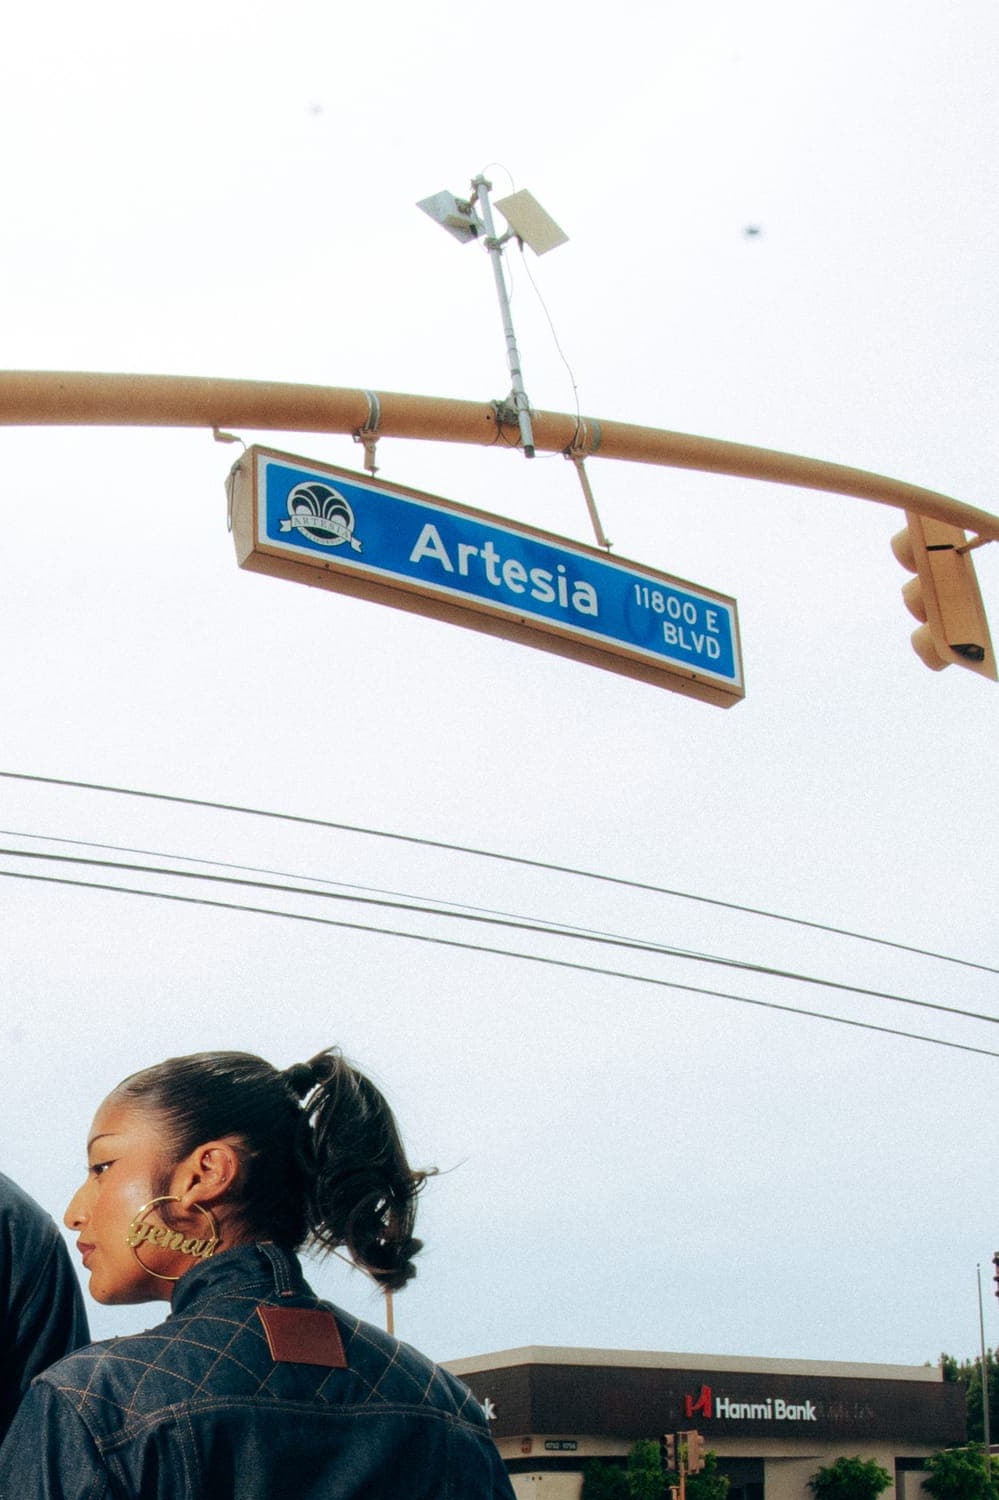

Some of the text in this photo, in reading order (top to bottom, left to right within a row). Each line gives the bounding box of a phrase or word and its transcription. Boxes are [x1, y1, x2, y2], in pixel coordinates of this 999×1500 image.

[294, 517, 349, 539] ARTESIA
[409, 523, 600, 617] Artesia
[633, 583, 721, 634] 11800 E
[662, 620, 722, 660] BLVD
[715, 1396, 772, 1420] Hanmi
[774, 1398, 817, 1421] Bank
